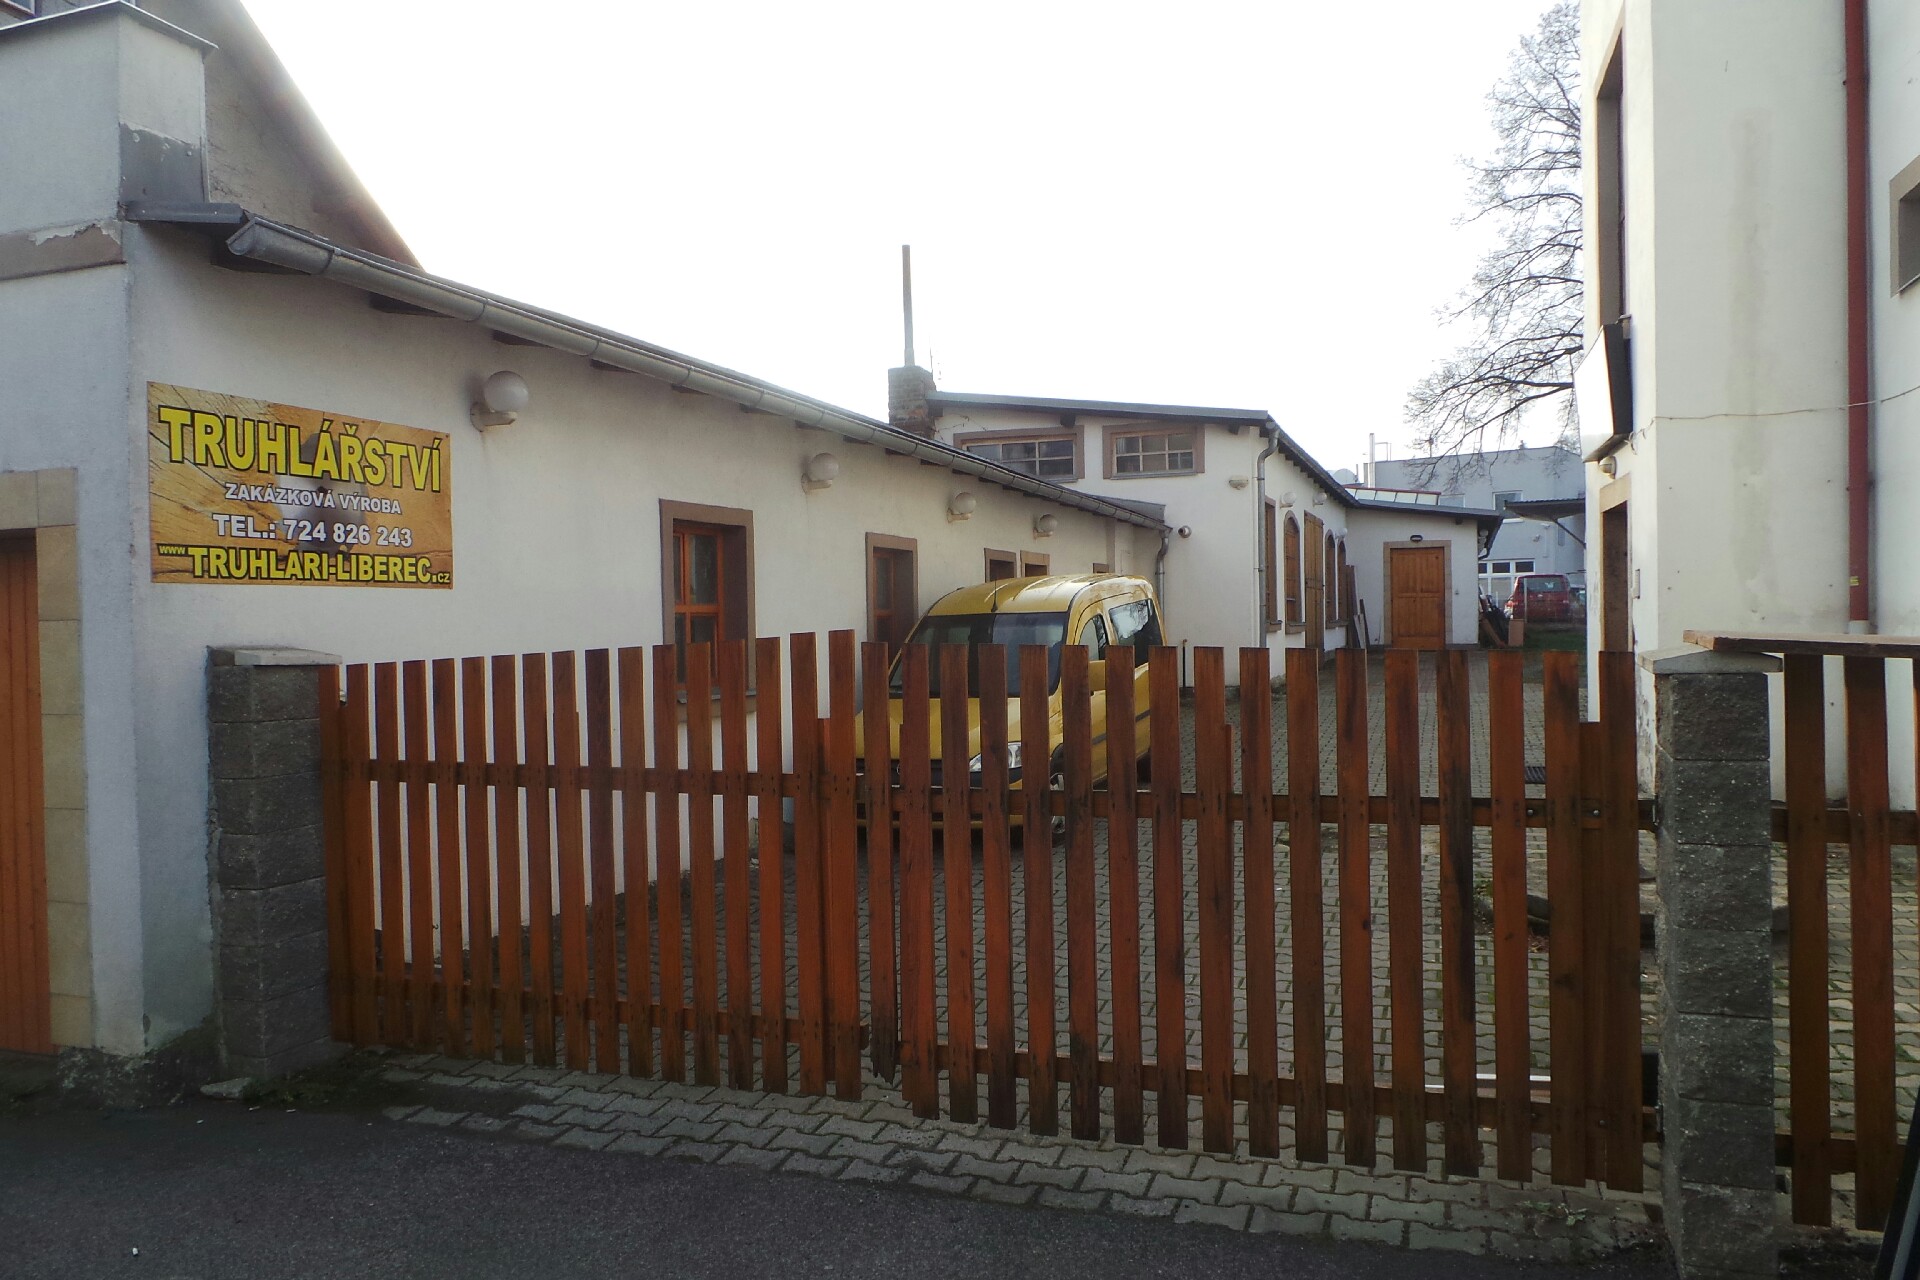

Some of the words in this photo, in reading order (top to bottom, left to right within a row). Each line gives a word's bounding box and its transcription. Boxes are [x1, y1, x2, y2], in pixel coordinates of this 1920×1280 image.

[158, 405, 442, 492] TRUHLÁŘSTVÍ
[224, 483, 336, 508] ZAKÁZKOVÁ
[339, 493, 402, 514] VÝROBA
[212, 513, 276, 539] TEL.:
[283, 519, 327, 542] 724
[332, 522, 371, 545] 826
[375, 526, 413, 548] 243
